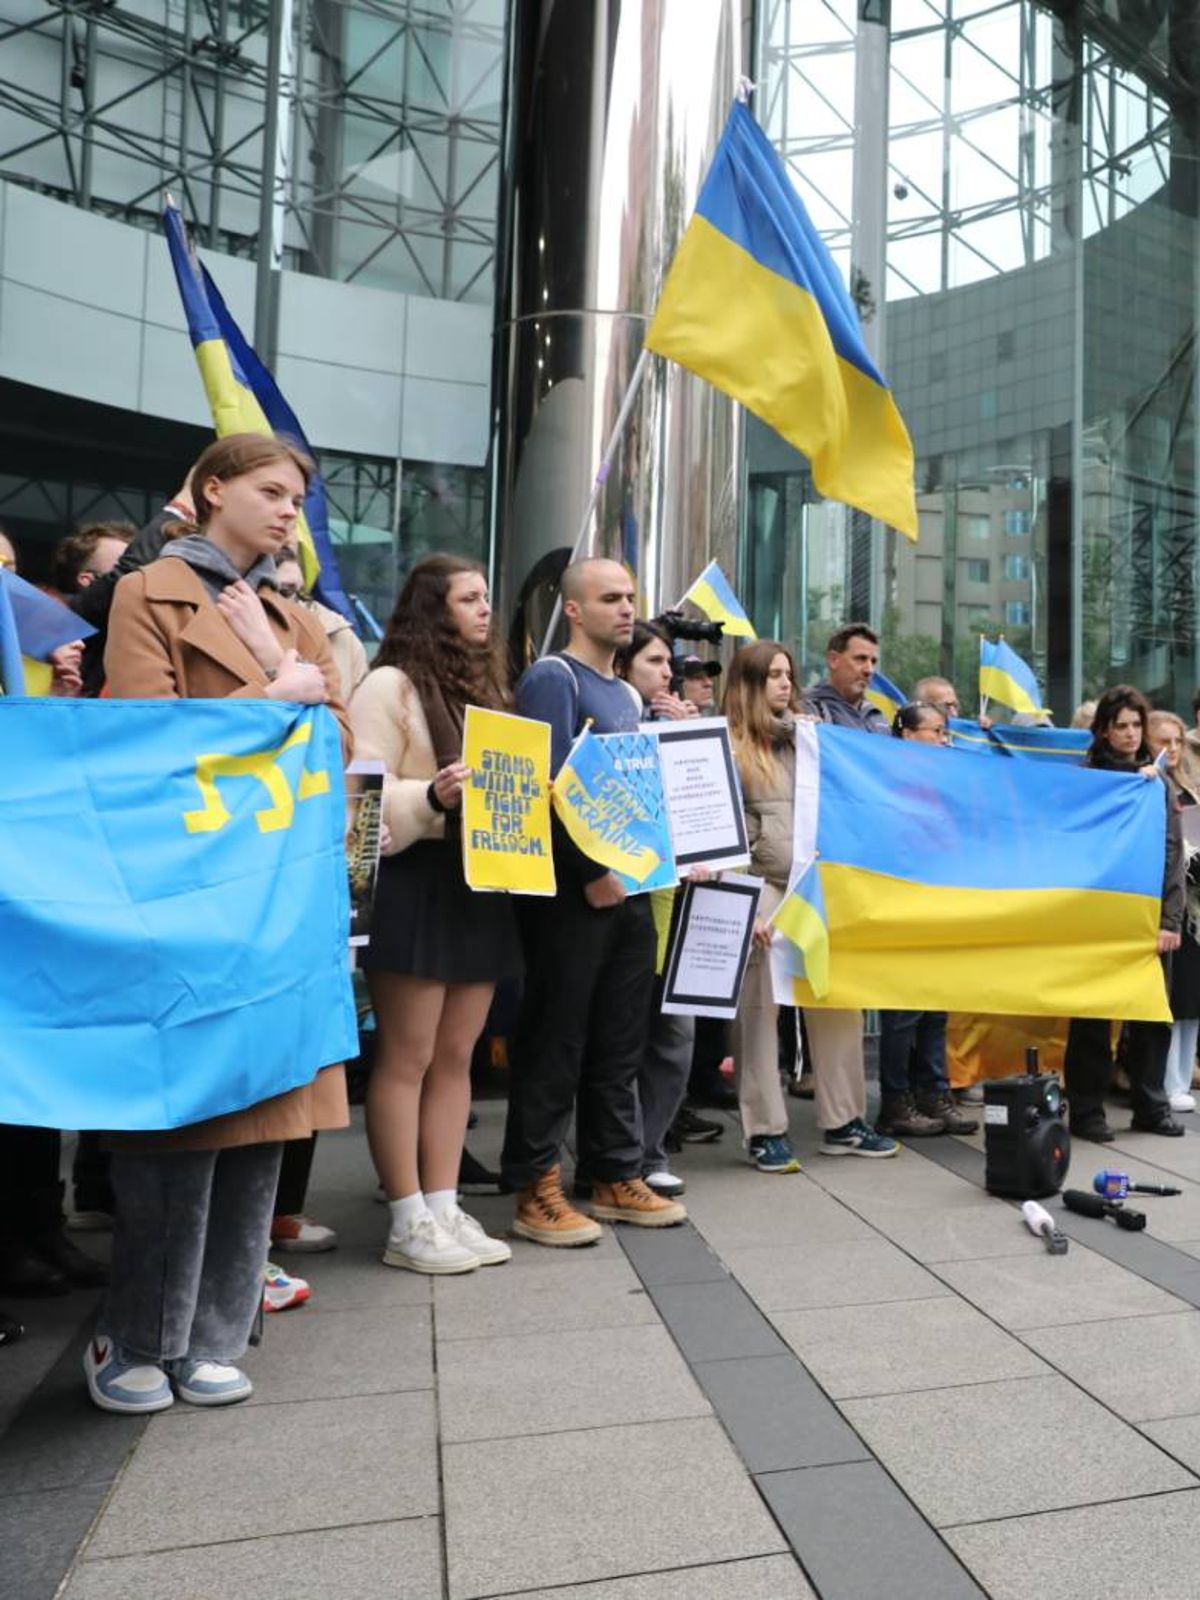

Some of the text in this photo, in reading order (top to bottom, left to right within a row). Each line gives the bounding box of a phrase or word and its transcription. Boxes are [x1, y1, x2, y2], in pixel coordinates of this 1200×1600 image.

[481, 749, 535, 777] STAND
[471, 771, 516, 794] WITH
[485, 791, 532, 815] FIGHT
[491, 812, 523, 835] FOR
[564, 783, 644, 857] UKRAINE
